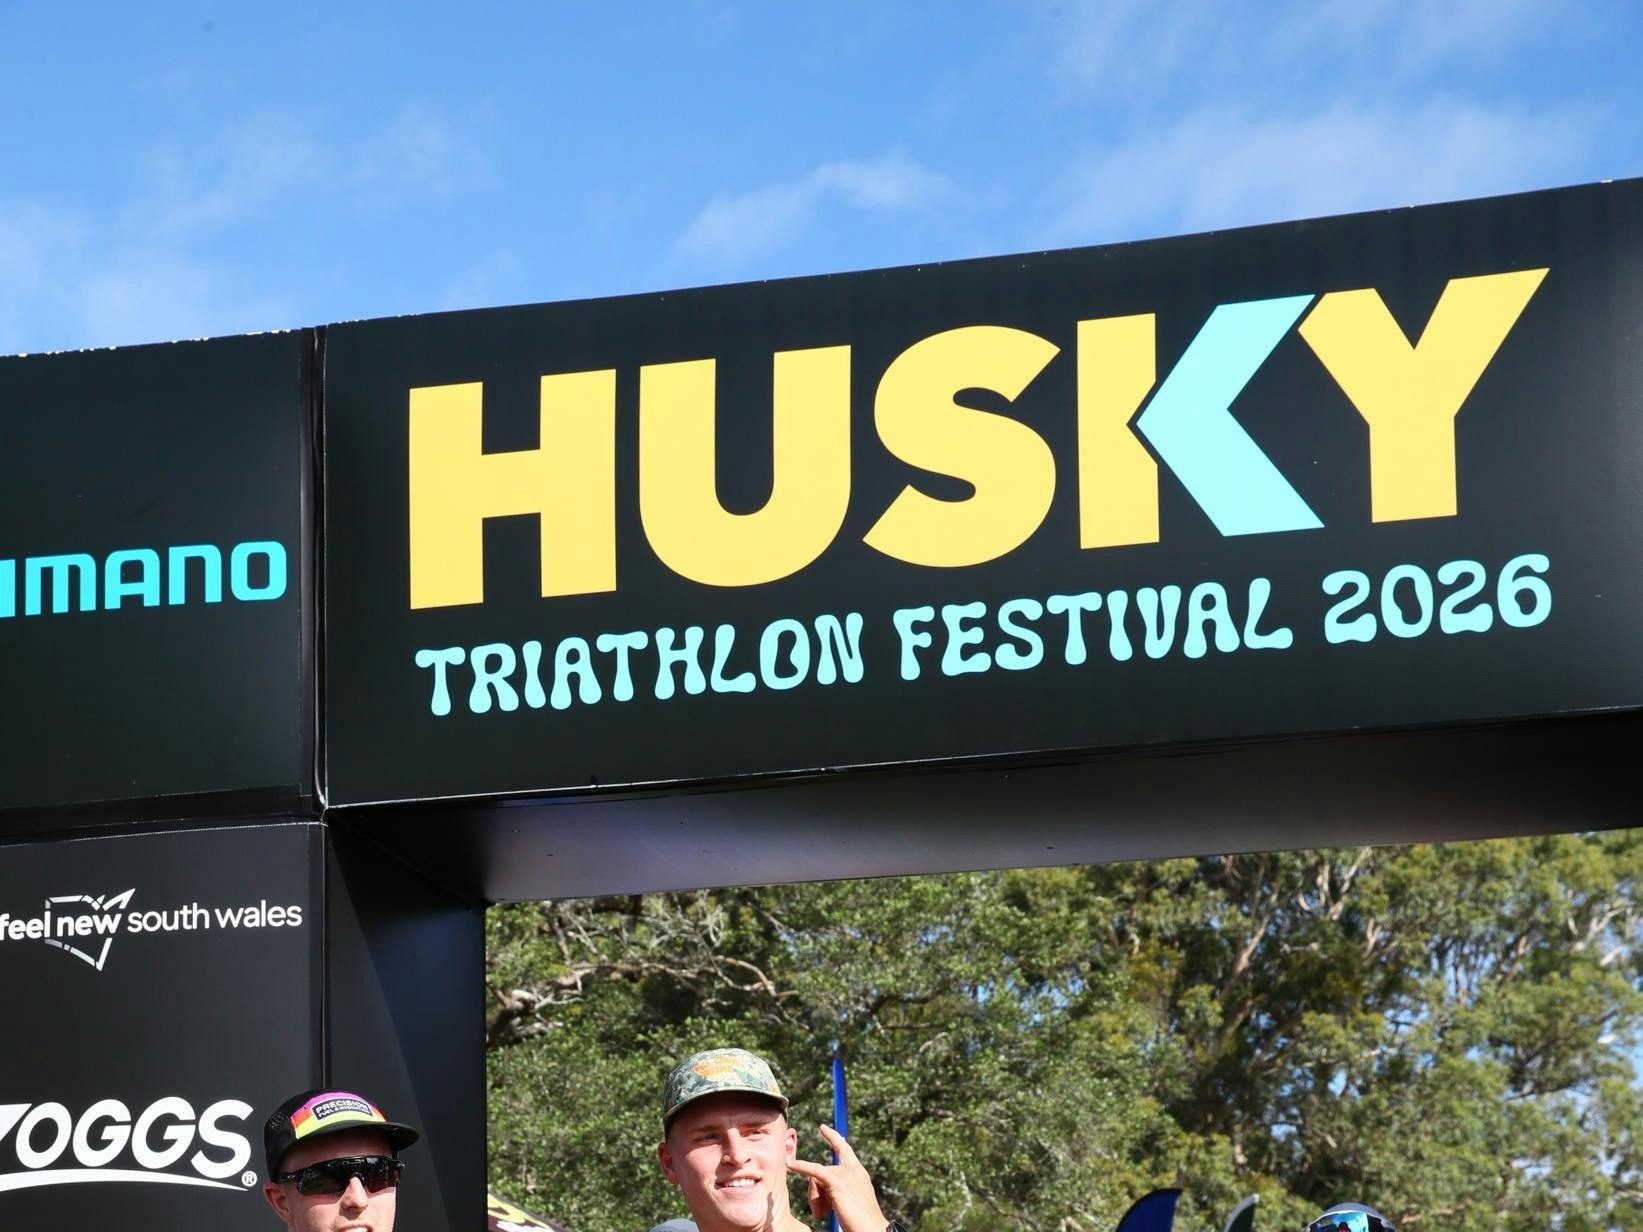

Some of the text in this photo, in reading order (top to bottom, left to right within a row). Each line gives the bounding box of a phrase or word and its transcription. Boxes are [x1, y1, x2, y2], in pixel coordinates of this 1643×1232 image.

[409, 267, 1550, 610] HUSKY
[0, 541, 287, 618] IMANO
[414, 553, 1553, 717] TRIATHLON FESTIVAL 2026
[0, 899, 303, 941] feel new south wales
[0, 1096, 254, 1179] OGGS
